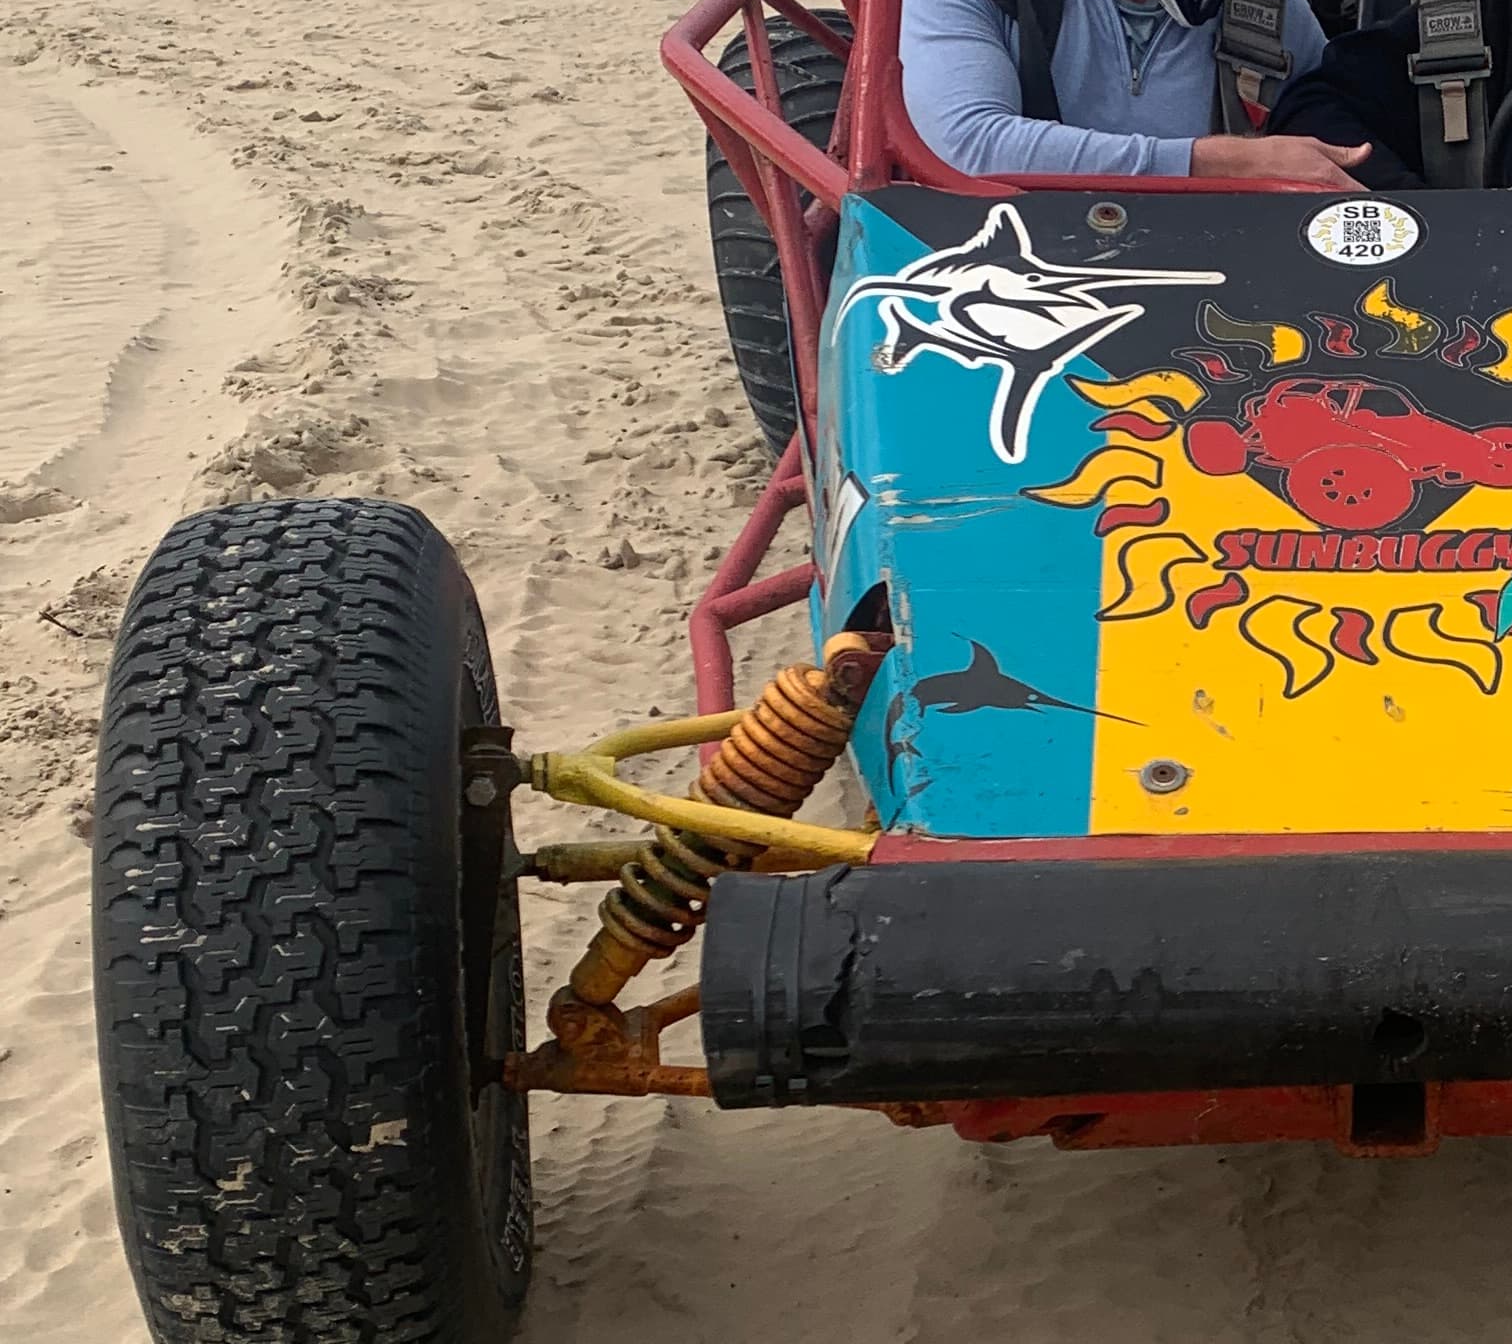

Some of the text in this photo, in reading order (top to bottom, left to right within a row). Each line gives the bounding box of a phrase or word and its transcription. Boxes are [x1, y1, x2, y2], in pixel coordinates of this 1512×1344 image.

[1428, 15, 1461, 30] CROW
[1343, 206, 1380, 218] SB
[1339, 244, 1384, 257] 420
